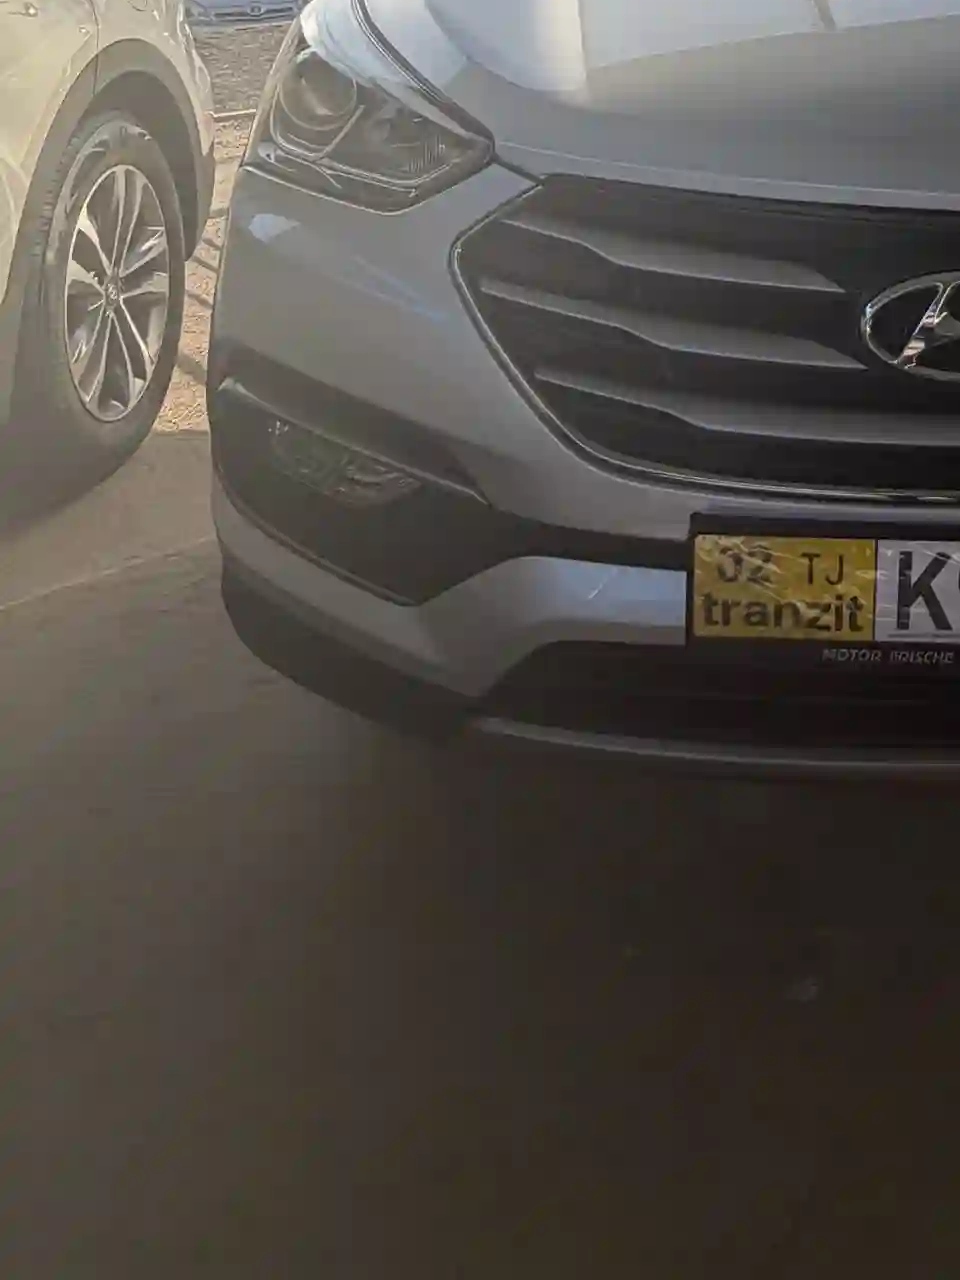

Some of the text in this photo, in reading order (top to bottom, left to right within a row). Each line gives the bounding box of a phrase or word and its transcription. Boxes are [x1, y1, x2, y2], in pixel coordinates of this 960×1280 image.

[717, 544, 844, 586] 02 TJ
[702, 592, 865, 633] tranzit
[822, 648, 882, 662] MOTOR
